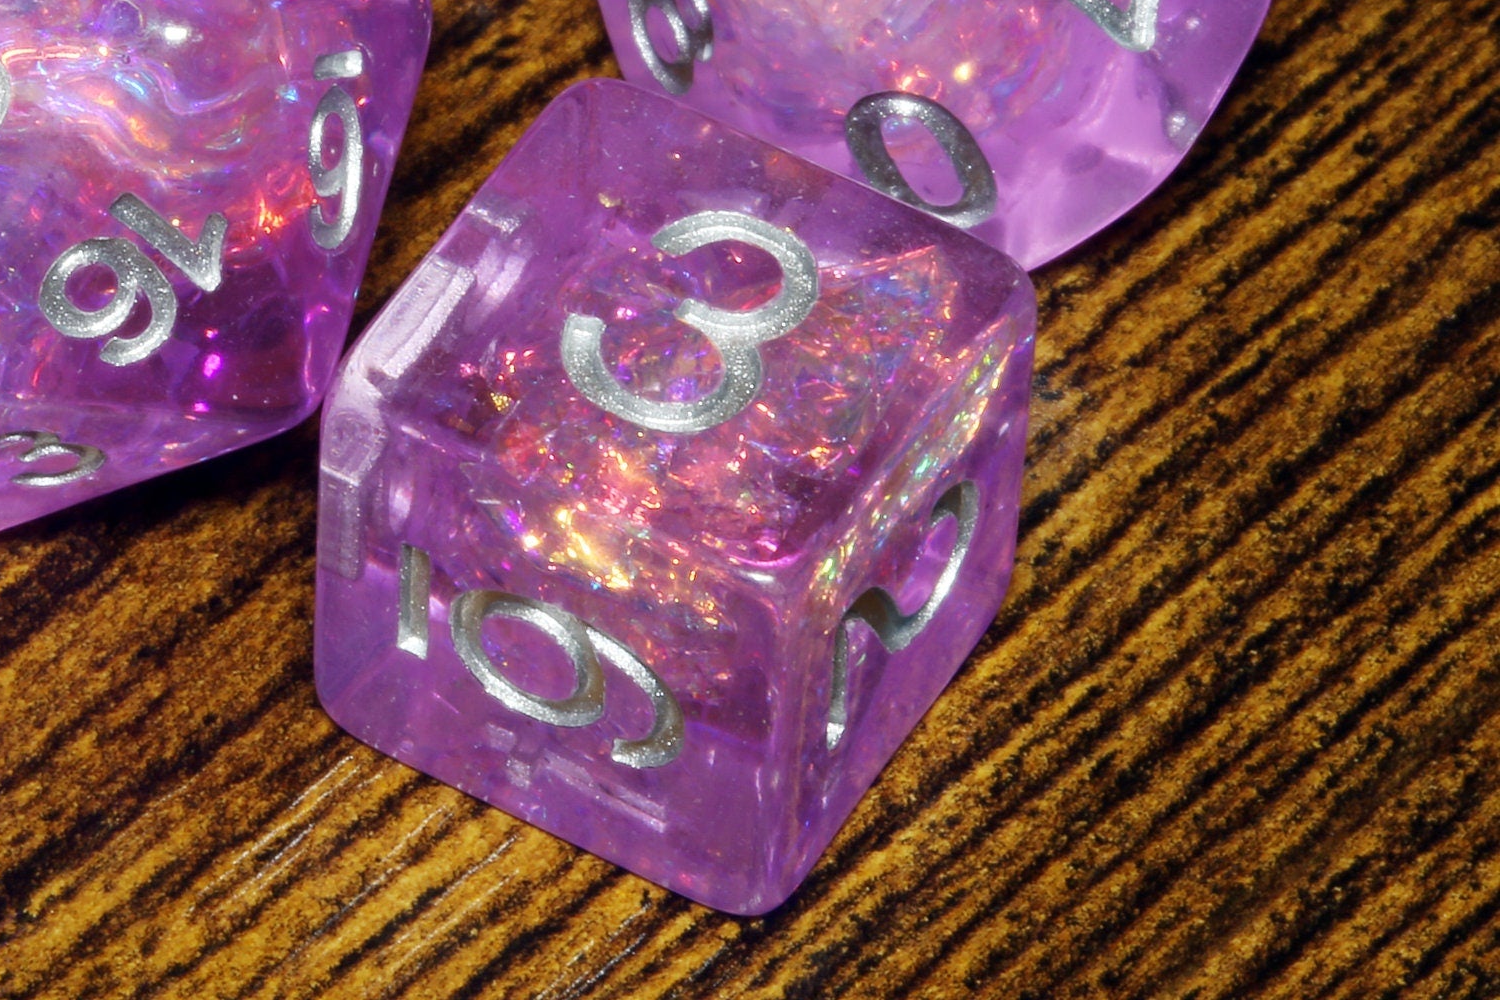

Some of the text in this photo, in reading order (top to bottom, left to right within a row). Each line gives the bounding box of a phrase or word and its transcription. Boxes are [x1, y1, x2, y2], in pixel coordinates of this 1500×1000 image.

[845, 92, 996, 227] 0
[38, 192, 227, 366] 16
[560, 210, 818, 433] 3
[825, 481, 980, 749] 2
